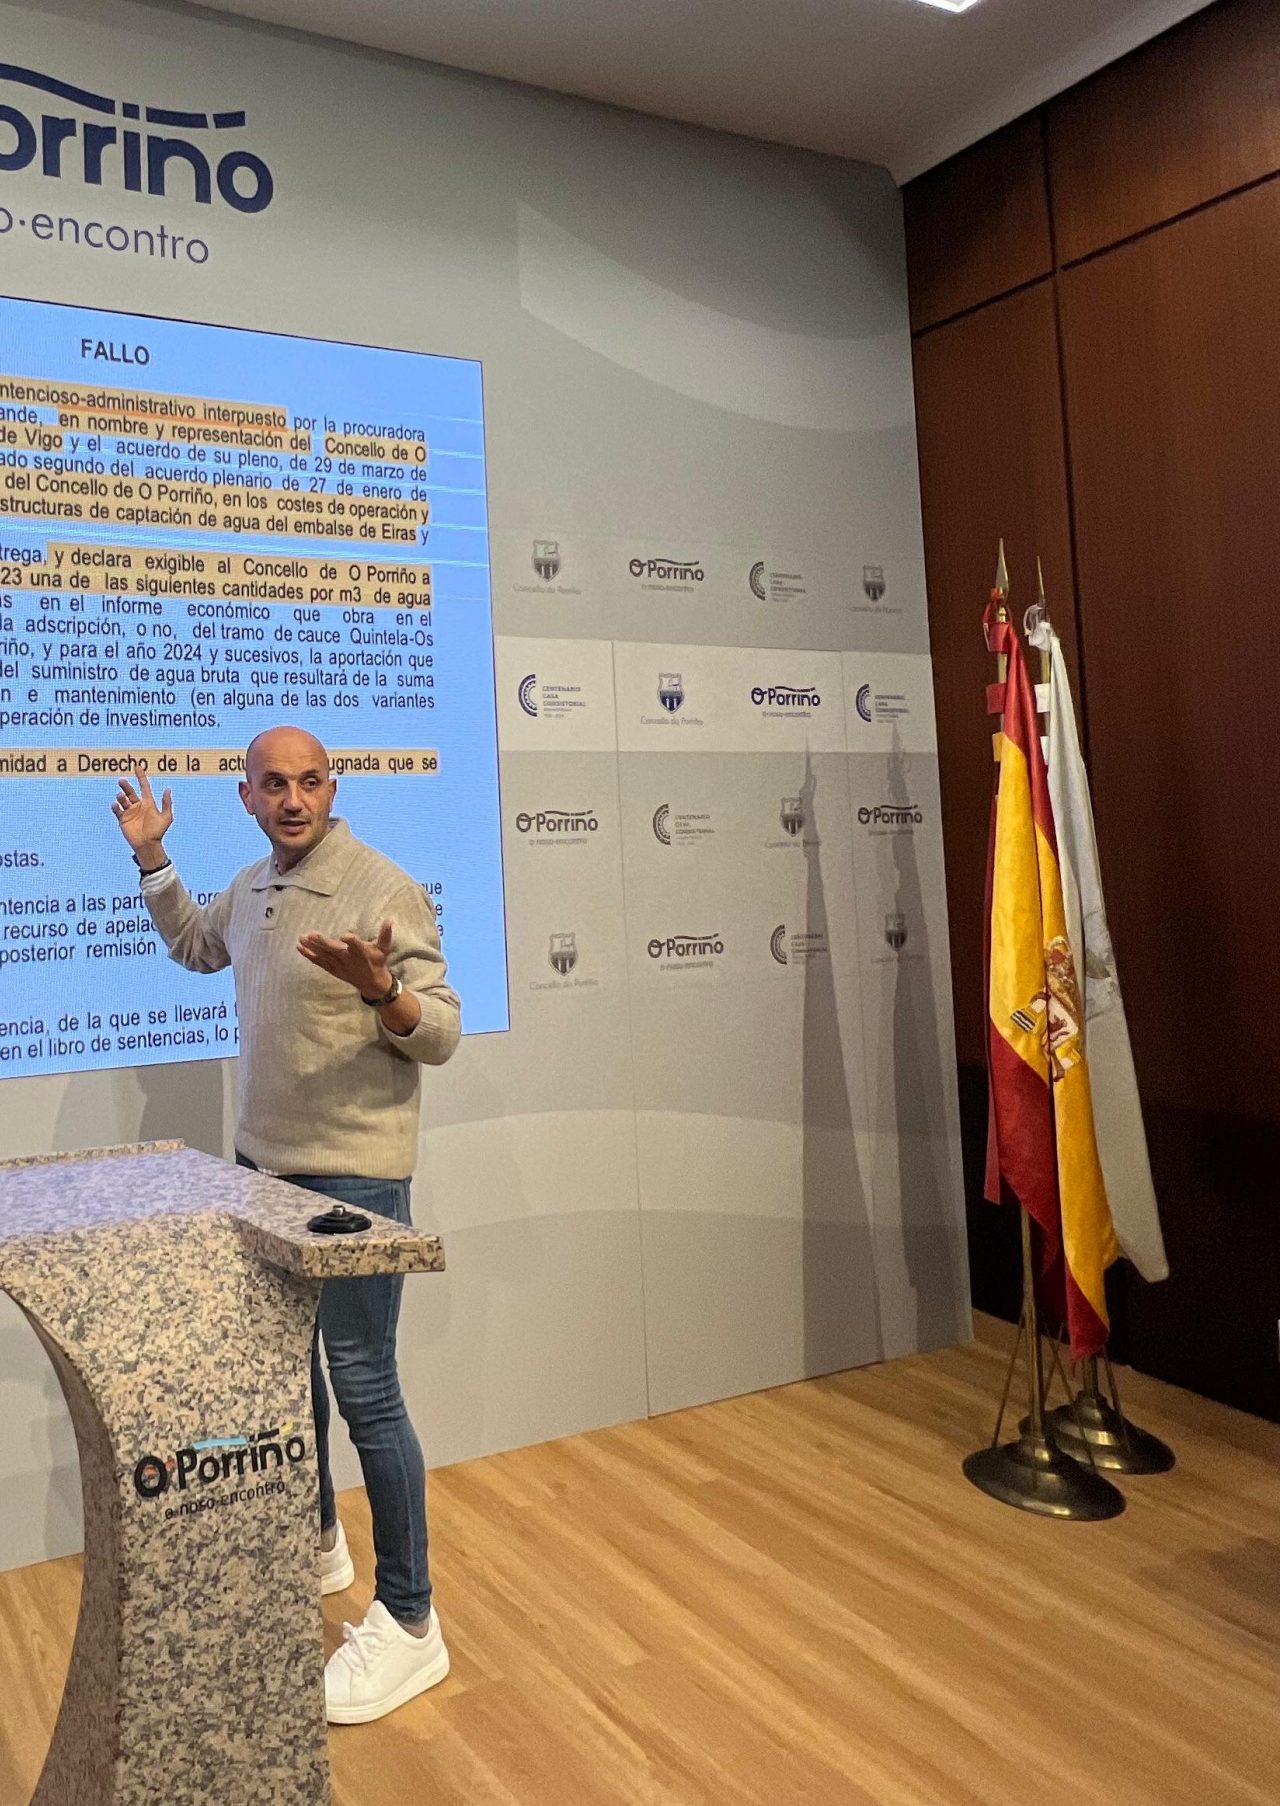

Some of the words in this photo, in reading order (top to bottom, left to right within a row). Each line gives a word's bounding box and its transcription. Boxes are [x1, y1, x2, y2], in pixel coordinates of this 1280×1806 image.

[81, 338, 150, 366] FALLO
[58, 413, 80, 429] en
[87, 411, 149, 436] nombre
[154, 423, 165, 442] y
[171, 419, 283, 451] representación
[289, 431, 311, 452] del
[324, 436, 386, 459] Concello
[391, 443, 409, 461] de
[414, 445, 427, 463] O
[202, 402, 288, 429] interpuesto
[293, 416, 317, 434] por
[323, 415, 337, 434] la
[343, 422, 426, 447] procuradora
[23, 426, 63, 453] Vigo
[68, 435, 80, 455] y
[86, 433, 101, 453] el
[116, 438, 181, 460] acuerdo
[187, 441, 207, 463] de
[213, 450, 232, 465] su
[238, 448, 283, 472] pleno,
[289, 453, 308, 472] de
[314, 455, 333, 474] 29
[337, 457, 356, 476] de
[361, 464, 405, 480] marzo
[410, 464, 427, 482] de
[54, 549, 65, 569] y
[70, 546, 132, 569] declara
[144, 552, 205, 576] exigible
[217, 556, 231, 575] al
[243, 557, 309, 579] Concello
[319, 562, 338, 581] de
[348, 563, 362, 582] O
[366, 564, 417, 585] Porriño
[421, 572, 431, 586] a
[39, 596, 61, 612] en
[69, 594, 85, 614] el
[101, 594, 163, 617] informe
[186, 600, 271, 621] económico
[293, 608, 321, 626] que
[342, 606, 375, 625] obra
[395, 612, 414, 626] en
[419, 610, 432, 627] el
[78, 706, 100, 727] de
[104, 707, 221, 729] investimentos.
[56, 757, 68, 773] a
[77, 752, 149, 774] Derecho
[157, 753, 178, 772] de
[185, 753, 201, 772] la
[387, 757, 414, 775] que
[421, 757, 438, 771] se
[65, 898, 77, 913] a
[81, 893, 107, 914] las
[3, 922, 69, 941] recurso
[75, 917, 98, 937] de
